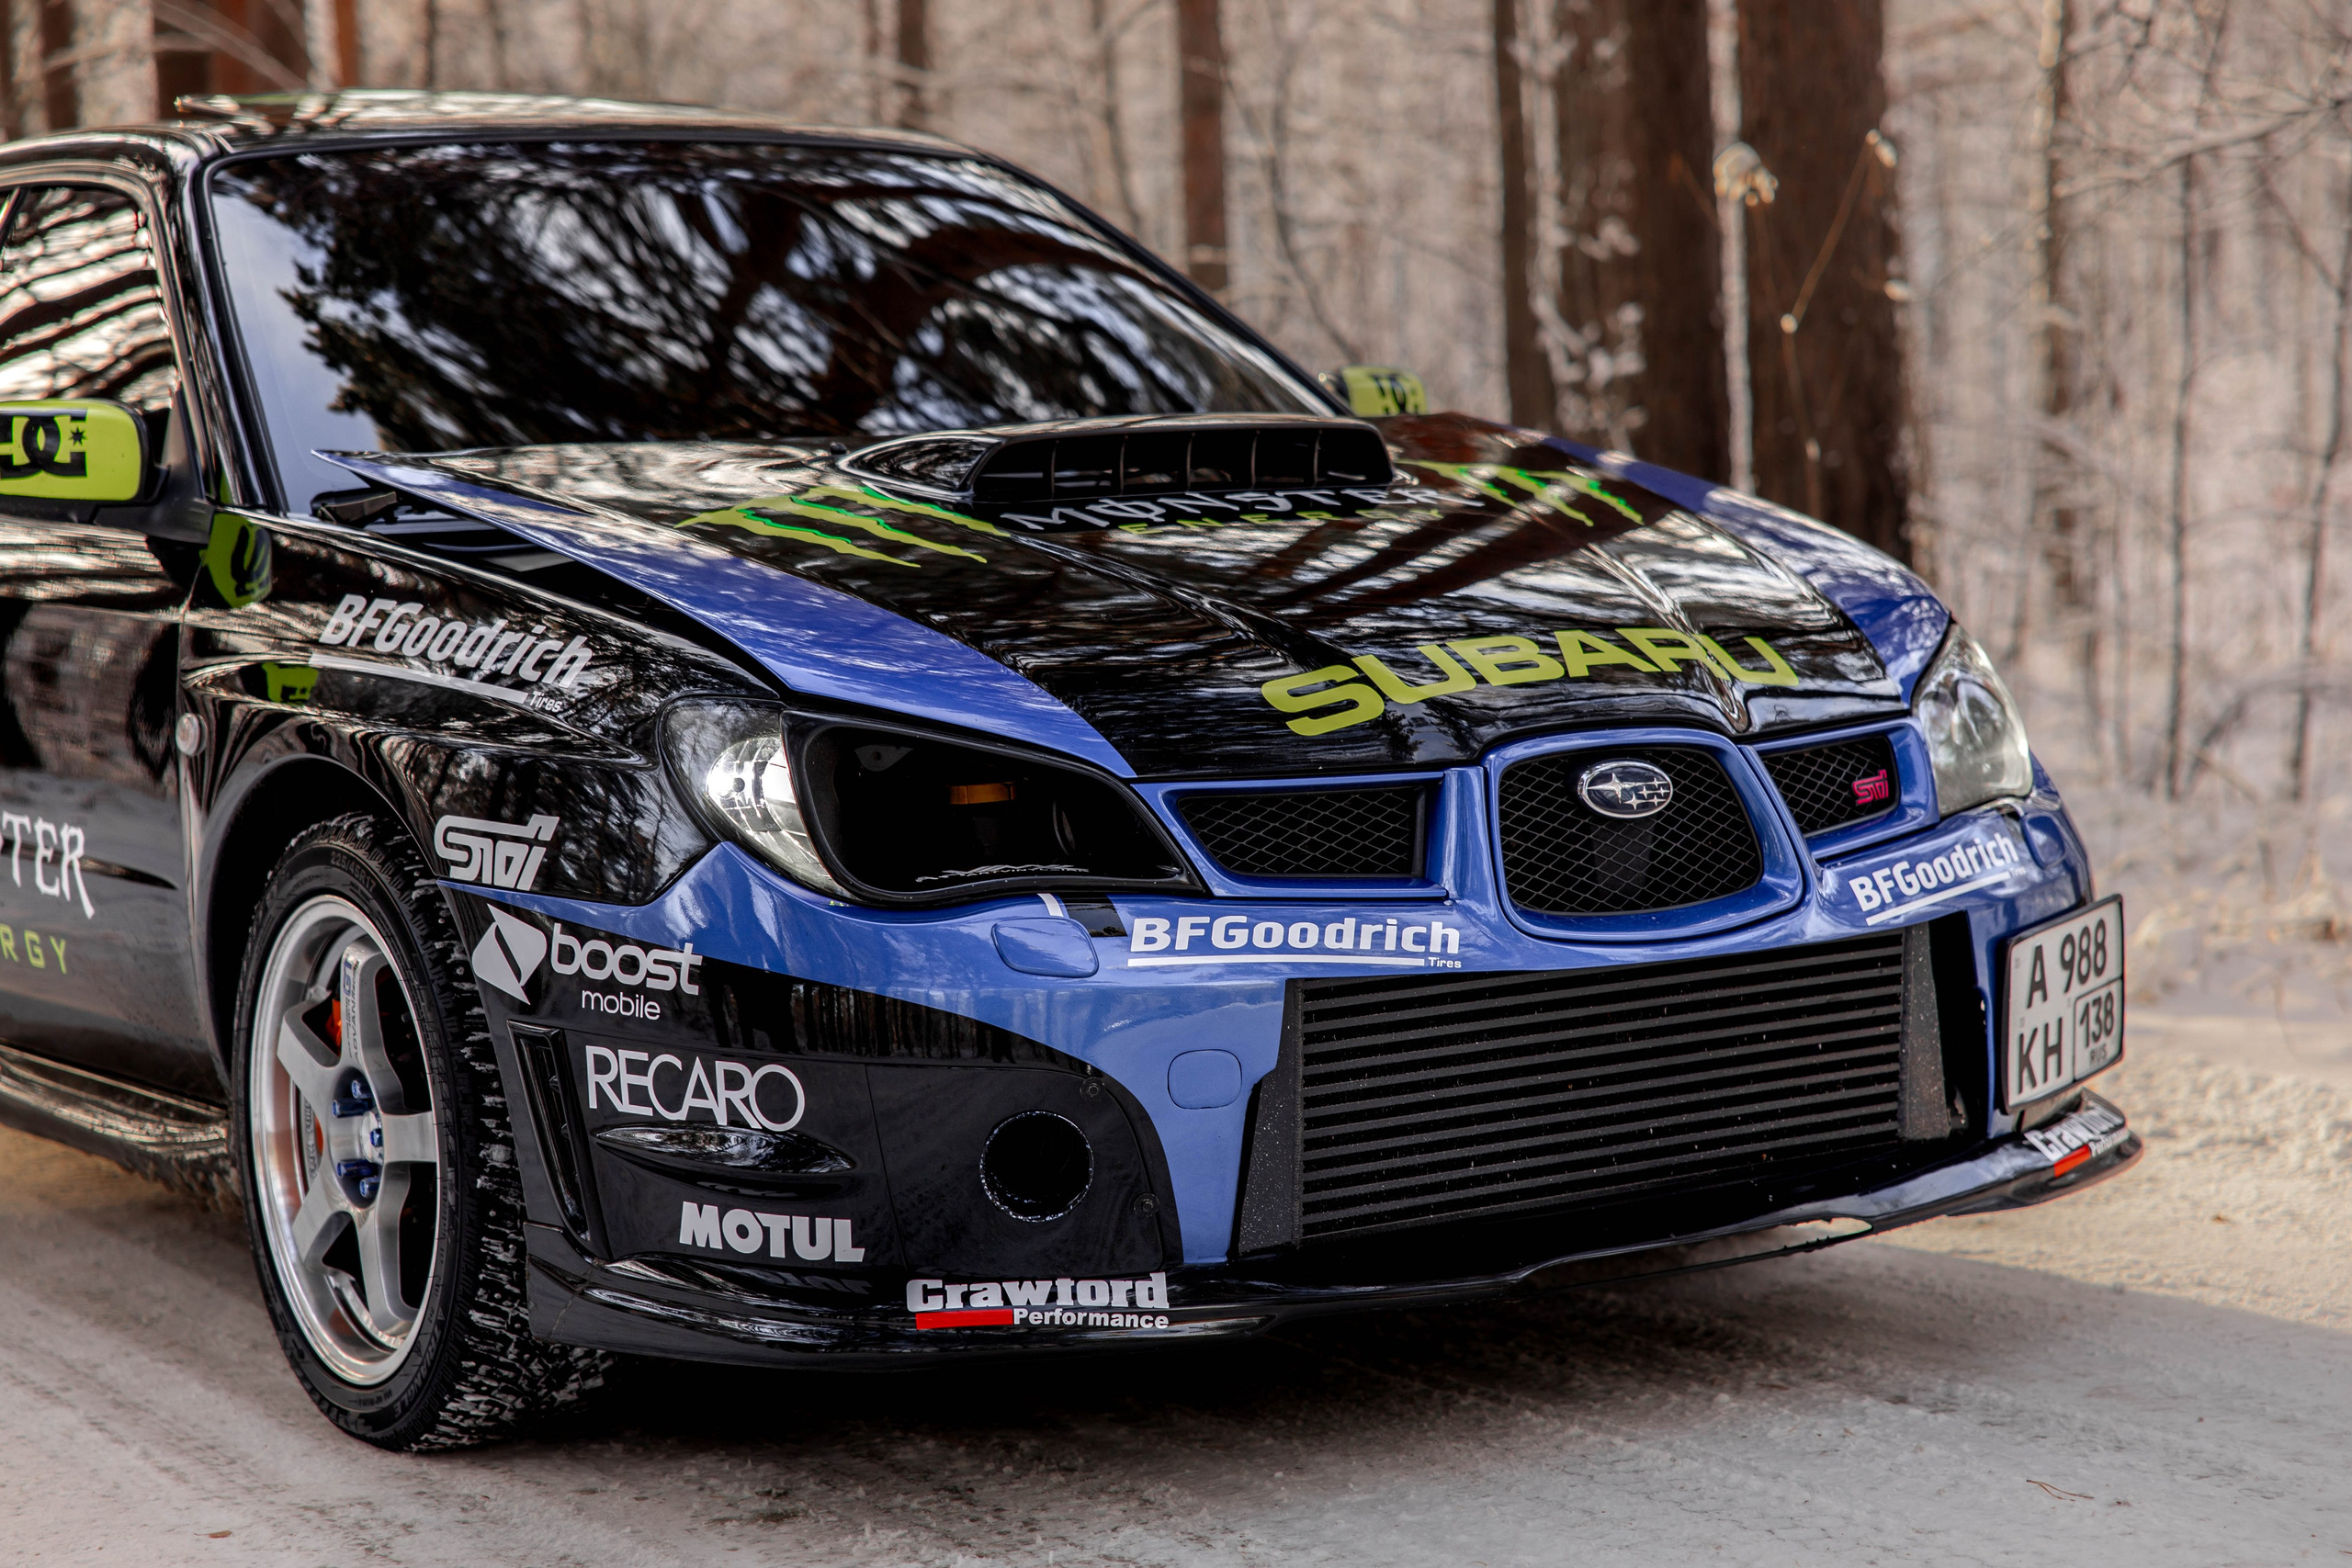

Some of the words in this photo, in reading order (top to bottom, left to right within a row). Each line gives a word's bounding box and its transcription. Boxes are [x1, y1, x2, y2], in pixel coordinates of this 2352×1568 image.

[1118, 508, 1444, 535] ENERGY
[319, 593, 593, 688] BFGoodrich
[528, 691, 562, 713] Tires
[1261, 628, 1799, 736] SUBARU
[0, 810, 95, 919] TER
[1849, 833, 2018, 912] BFGoodrich
[551, 923, 702, 995] boost
[1130, 916, 1460, 953] BFGoodrich
[1428, 957, 1462, 969] Tires
[2027, 944, 2048, 1009] A
[2060, 919, 2107, 993] 988
[582, 990, 661, 1021] mobile
[2079, 991, 2114, 1048] 138
[2018, 1016, 2063, 1095] KH
[585, 1045, 805, 1132] RECARO
[679, 1201, 865, 1262] MOTUL
[906, 1271, 1170, 1312] Crawford
[1013, 1308, 1169, 1329] Performance
